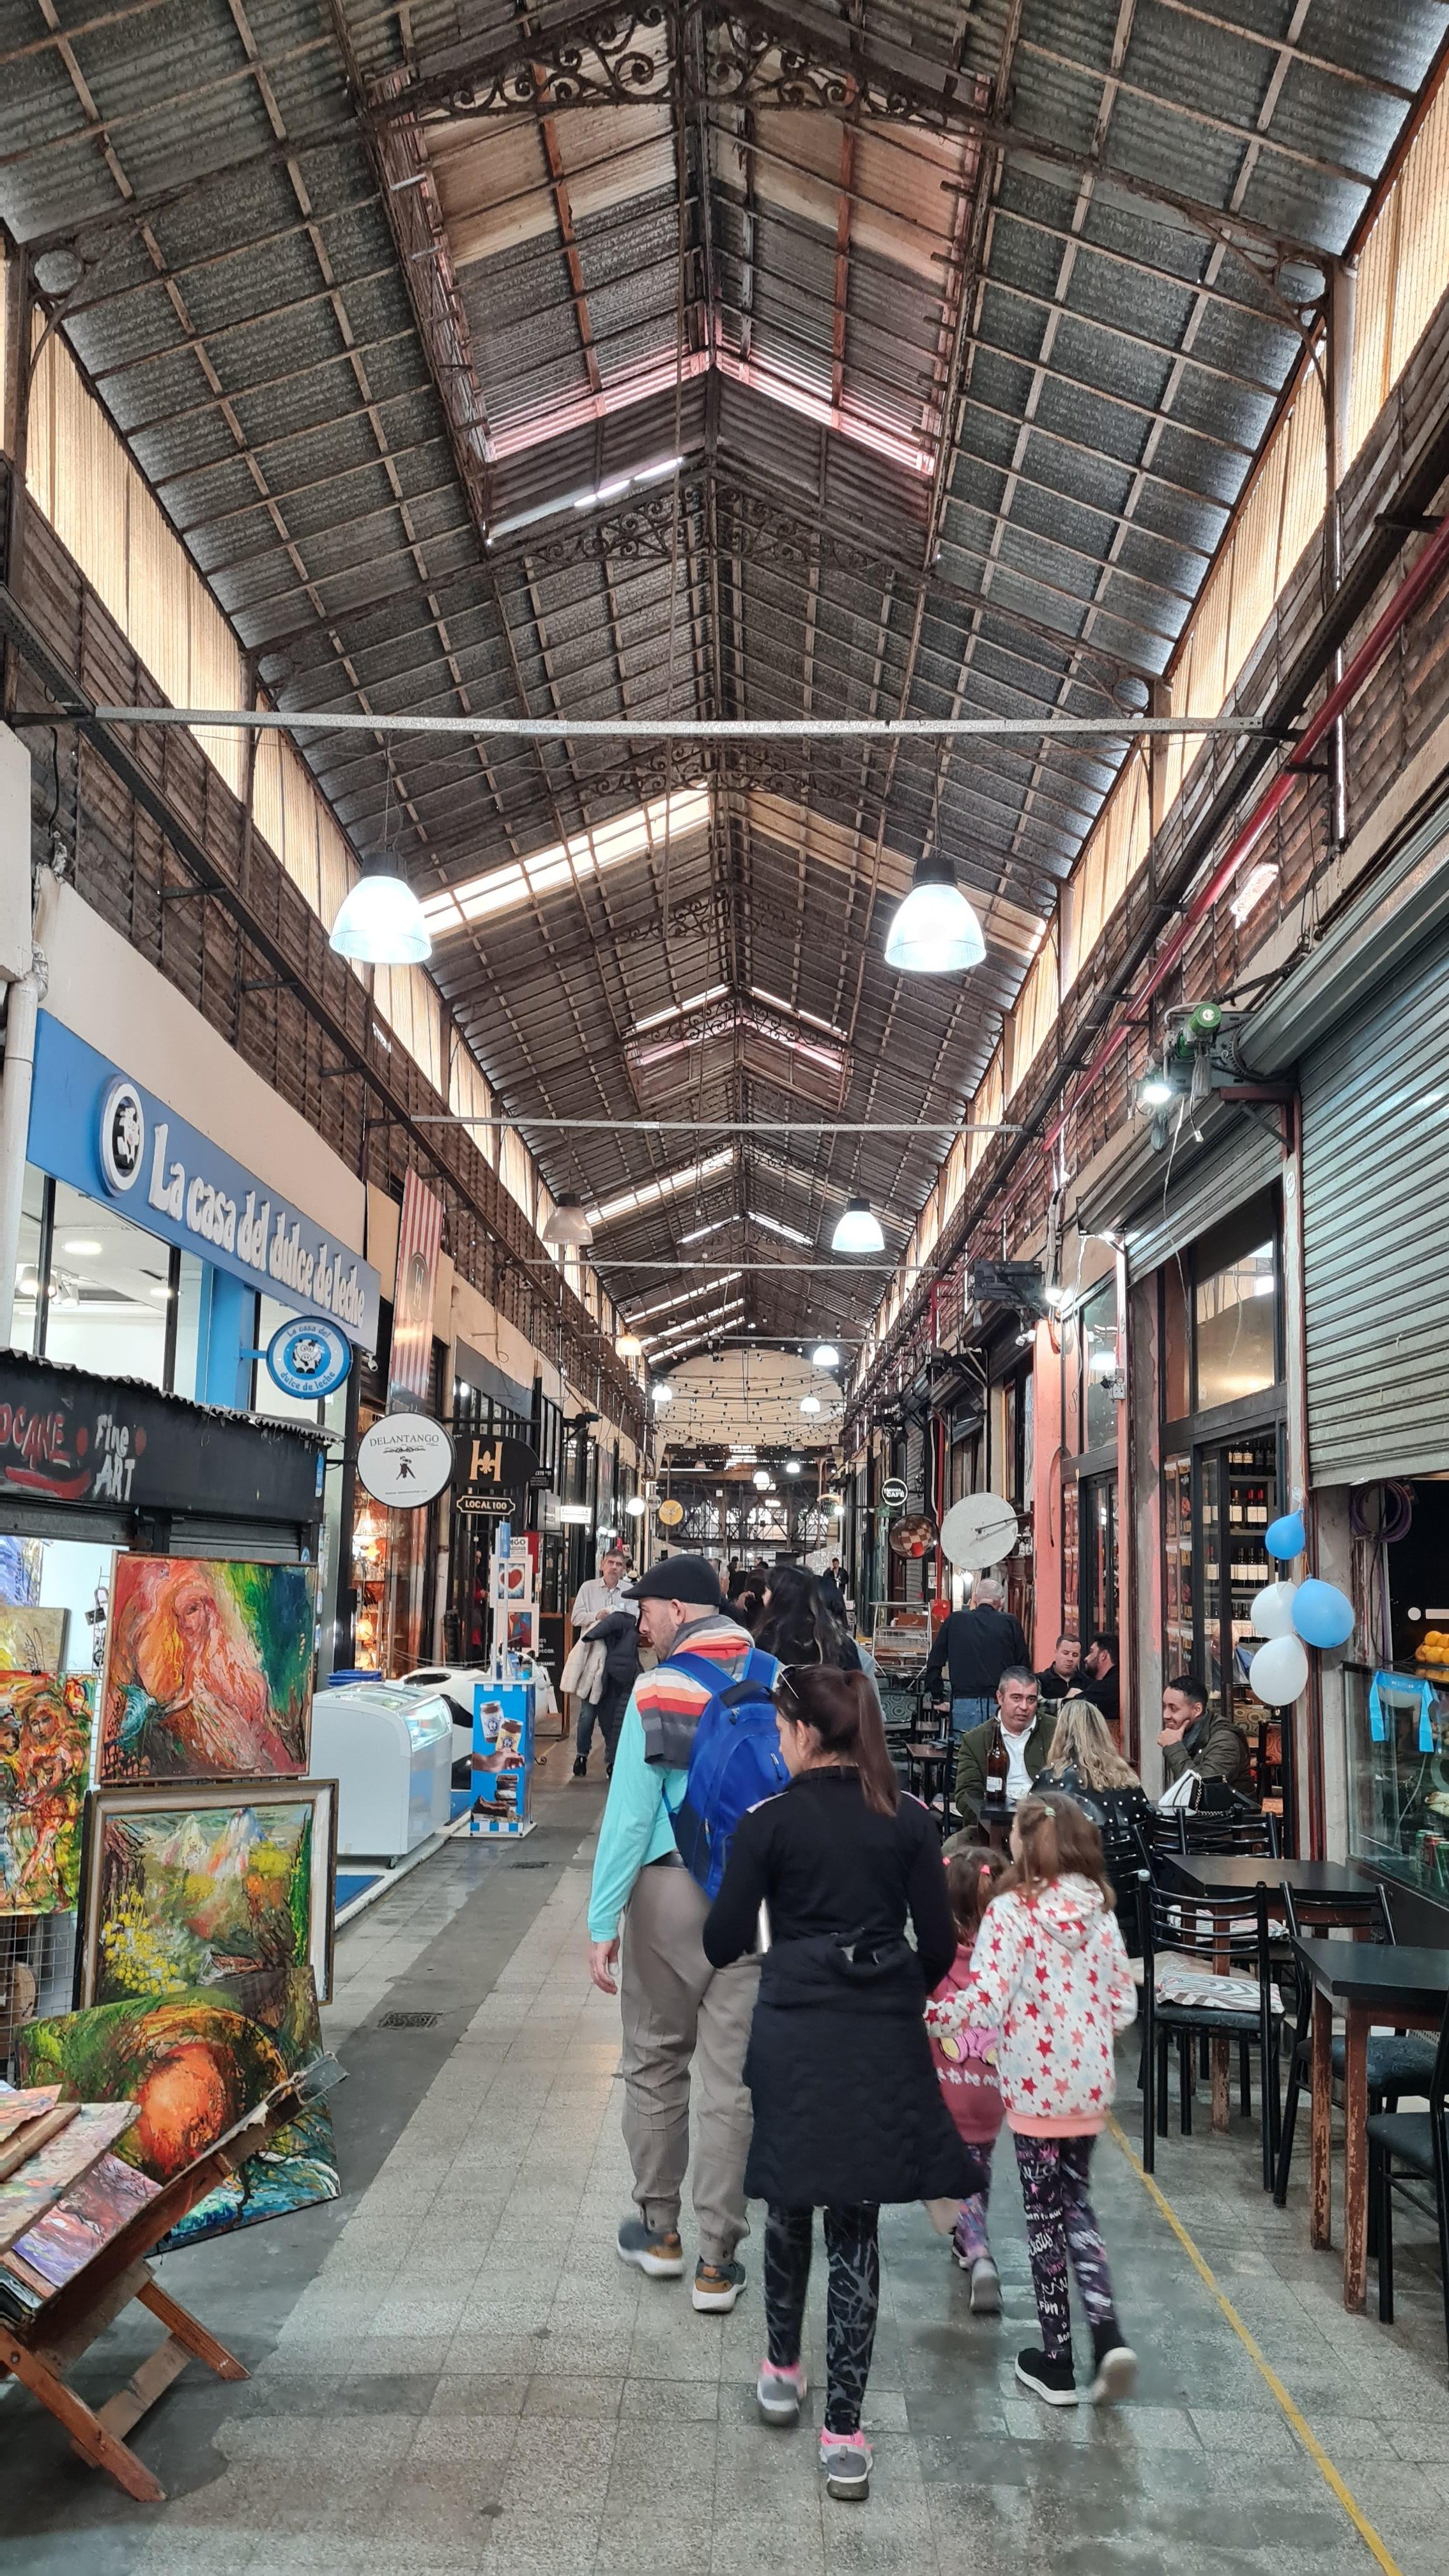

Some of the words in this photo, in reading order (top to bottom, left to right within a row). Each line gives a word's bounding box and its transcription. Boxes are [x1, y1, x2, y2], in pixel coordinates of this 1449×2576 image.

[148, 1123, 185, 1222] La
[186, 1176, 236, 1254] casa
[237, 1190, 270, 1272] del
[269, 1212, 314, 1298] dulce
[313, 1243, 333, 1309] de
[332, 1254, 365, 1329] leche
[287, 1329, 297, 1337] La
[318, 1327, 331, 1338] del
[280, 1372, 300, 1390] dulce
[303, 1383, 313, 1391] de
[314, 1371, 335, 1388] leche
[95, 1414, 130, 1457] Fine
[369, 1434, 440, 1447] DELANTANGO
[93, 1453, 135, 1501] ART
[465, 1500, 491, 1510] LOCAL
[493, 1501, 507, 1510] 100
